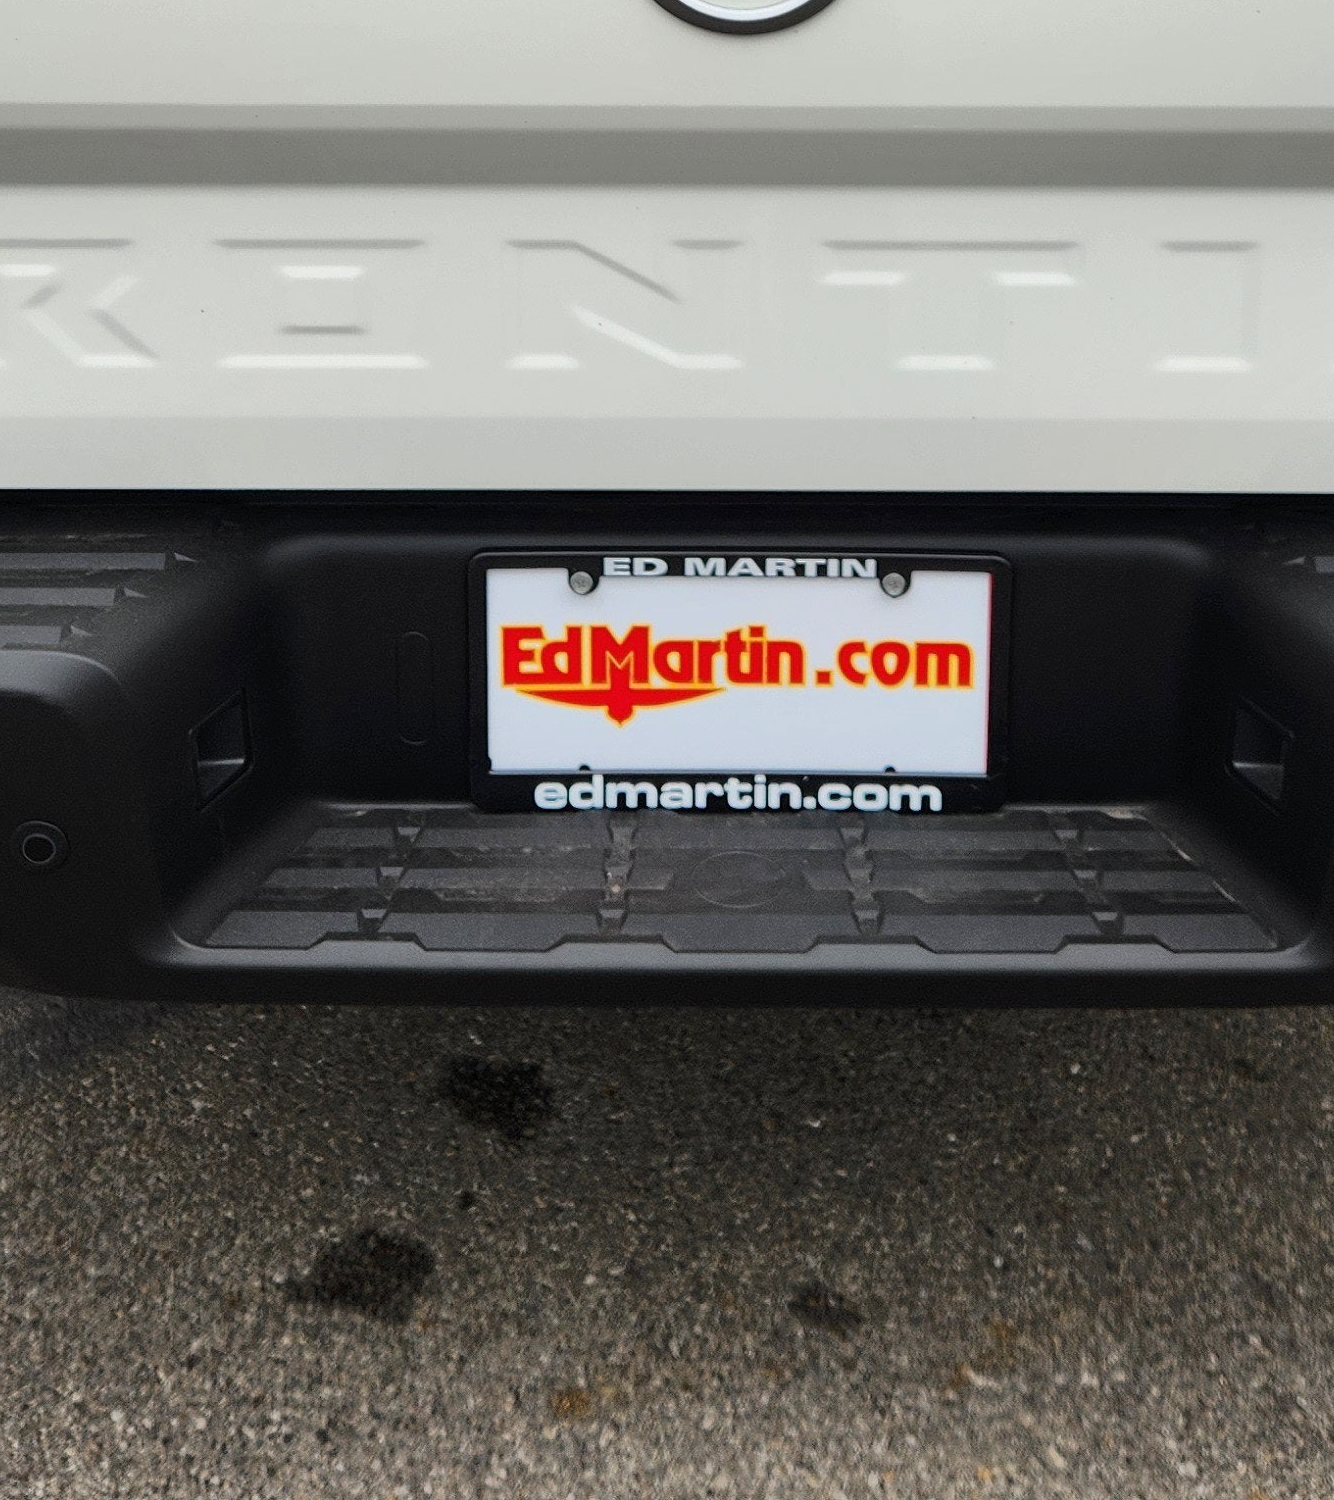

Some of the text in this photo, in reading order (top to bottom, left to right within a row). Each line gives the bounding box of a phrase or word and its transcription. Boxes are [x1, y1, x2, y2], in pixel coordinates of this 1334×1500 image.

[603, 557, 877, 579] ED MARTIN
[534, 775, 943, 812] edmartin.com
